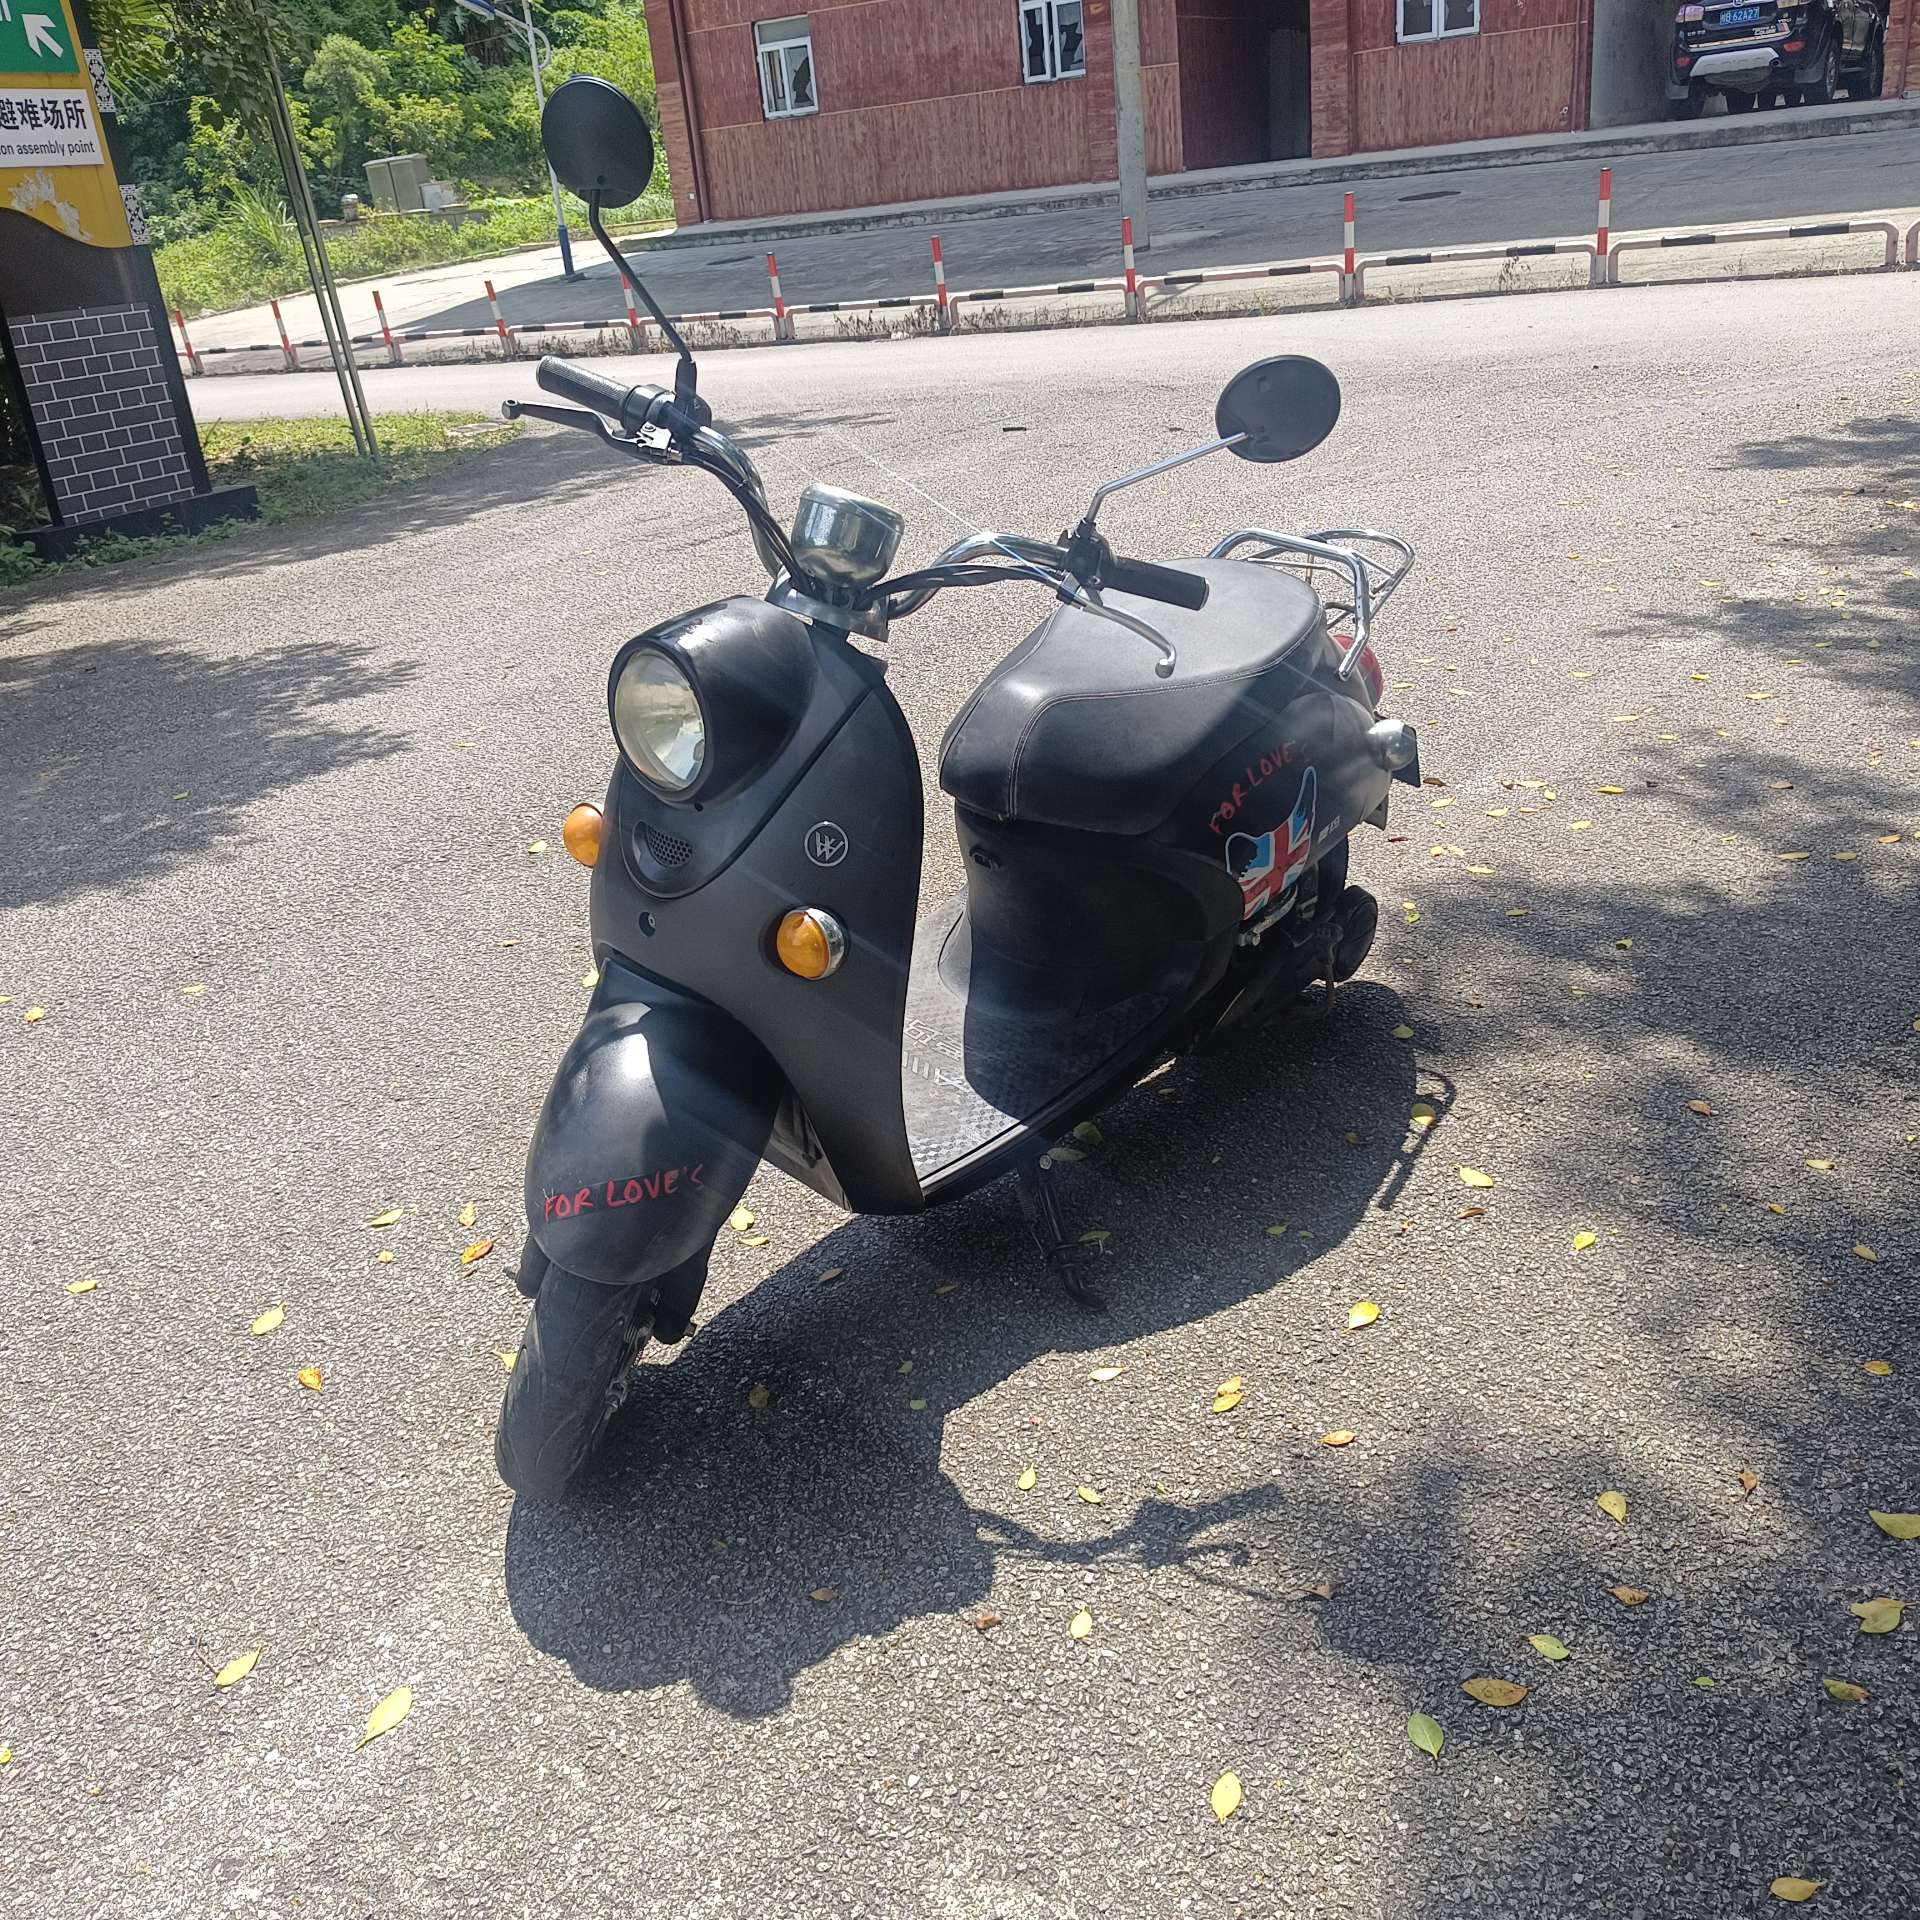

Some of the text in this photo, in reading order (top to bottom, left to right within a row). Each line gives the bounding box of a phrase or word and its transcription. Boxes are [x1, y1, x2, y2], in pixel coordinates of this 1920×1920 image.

[0, 98, 87, 130] 避难场所
[0, 140, 95, 156] on assembly point
[543, 1163, 705, 1222] FOR LOVE'S
